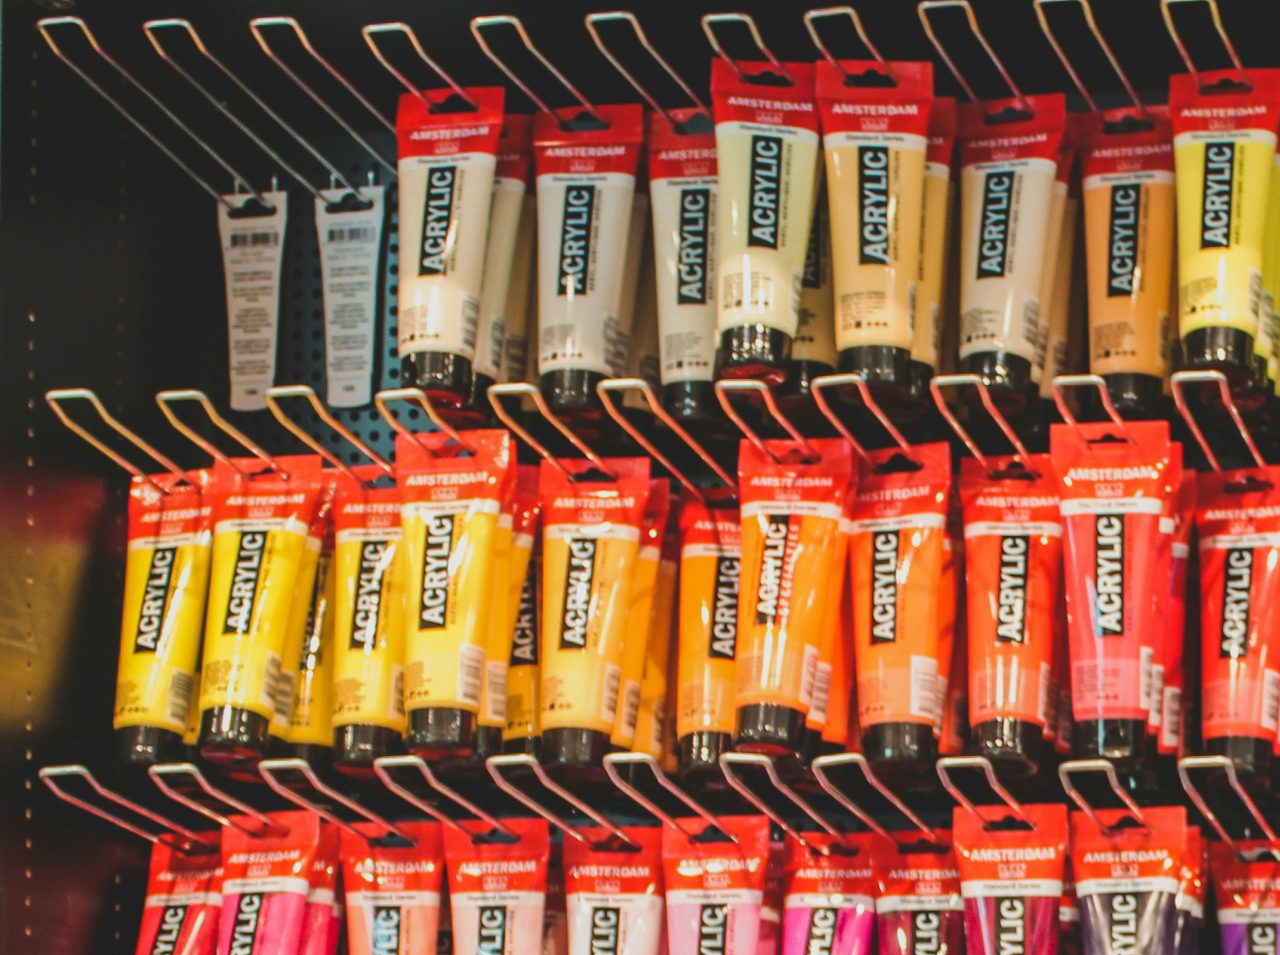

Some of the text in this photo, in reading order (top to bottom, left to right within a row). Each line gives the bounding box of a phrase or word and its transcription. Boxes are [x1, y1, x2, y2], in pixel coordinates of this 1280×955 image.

[410, 126, 490, 141] AMSTERDAM
[545, 146, 626, 158] AMSTERDAM
[728, 96, 814, 112] AMSTERDAM
[832, 104, 918, 117] AMSTERDAM
[1181, 106, 1267, 118] AMSTERDAM
[423, 170, 453, 272] ACRYLIC
[562, 190, 590, 290] ACRYLIC
[752, 140, 779, 244] ACRYLIC
[862, 151, 888, 262] ACRYLIC
[981, 176, 1010, 274] ACRYLIC
[1111, 188, 1136, 292] ACRYLIC
[1203, 146, 1232, 246] ACRYLIC
[680, 194, 706, 299] ACRYLIC
[406, 472, 489, 487] AMSTERDAM
[1068, 466, 1154, 480] AMSTERDAM
[136, 551, 174, 649] ACRYLIC
[227, 533, 264, 632] ACRYLIC
[354, 544, 385, 648] ACRYLIC
[422, 515, 451, 625] ACRYLIC
[564, 540, 594, 647] ACRYLIC
[713, 557, 740, 657] ACRYLIC
[757, 523, 787, 616] ACRYLIC
[873, 533, 899, 640] ACRYLIC
[998, 537, 1027, 642] ACRYLIC
[1099, 515, 1122, 633] ACRYLIC
[1222, 550, 1253, 656] ACRYLIC
[889, 869, 959, 880] AMSTERDA
[970, 847, 1056, 862] AMSTERDAM
